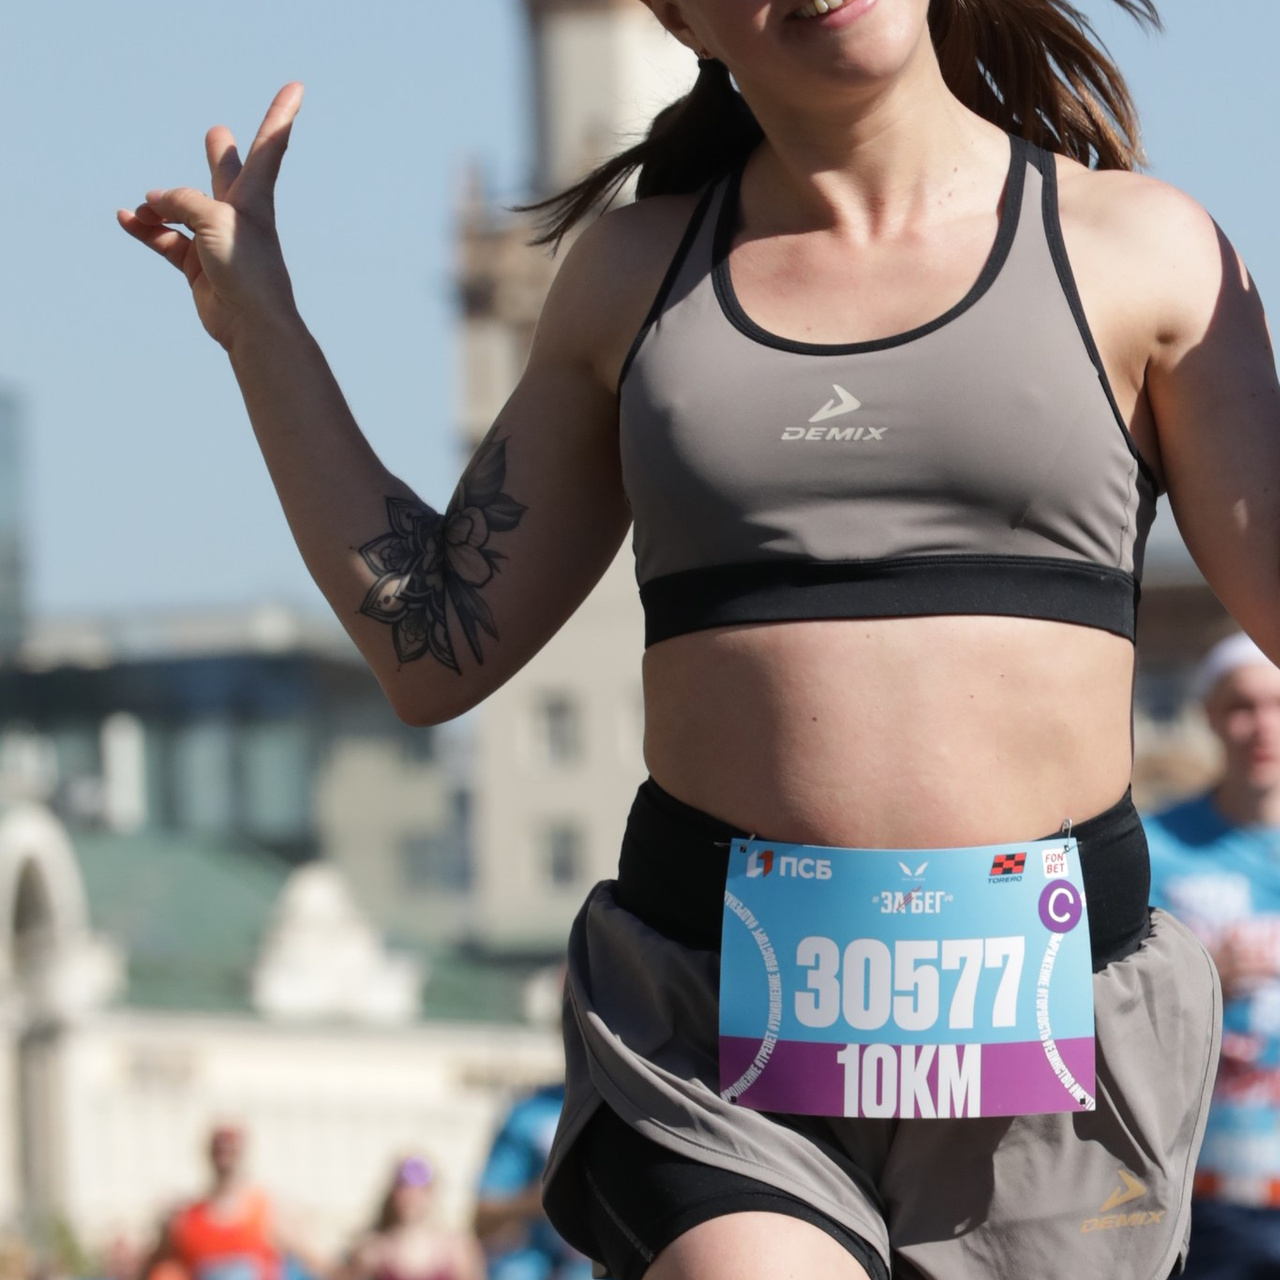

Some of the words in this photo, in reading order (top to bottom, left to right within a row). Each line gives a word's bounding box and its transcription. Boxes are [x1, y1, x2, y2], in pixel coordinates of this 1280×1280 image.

[780, 427, 888, 441] DEMIX
[1045, 853, 1064, 863] FON
[780, 856, 832, 880] ПСБ
[1046, 863, 1065, 874] BET
[988, 876, 1023, 884] TORERO
[795, 936, 1025, 1031] 30577
[1081, 1210, 1166, 1233] DEMIX
